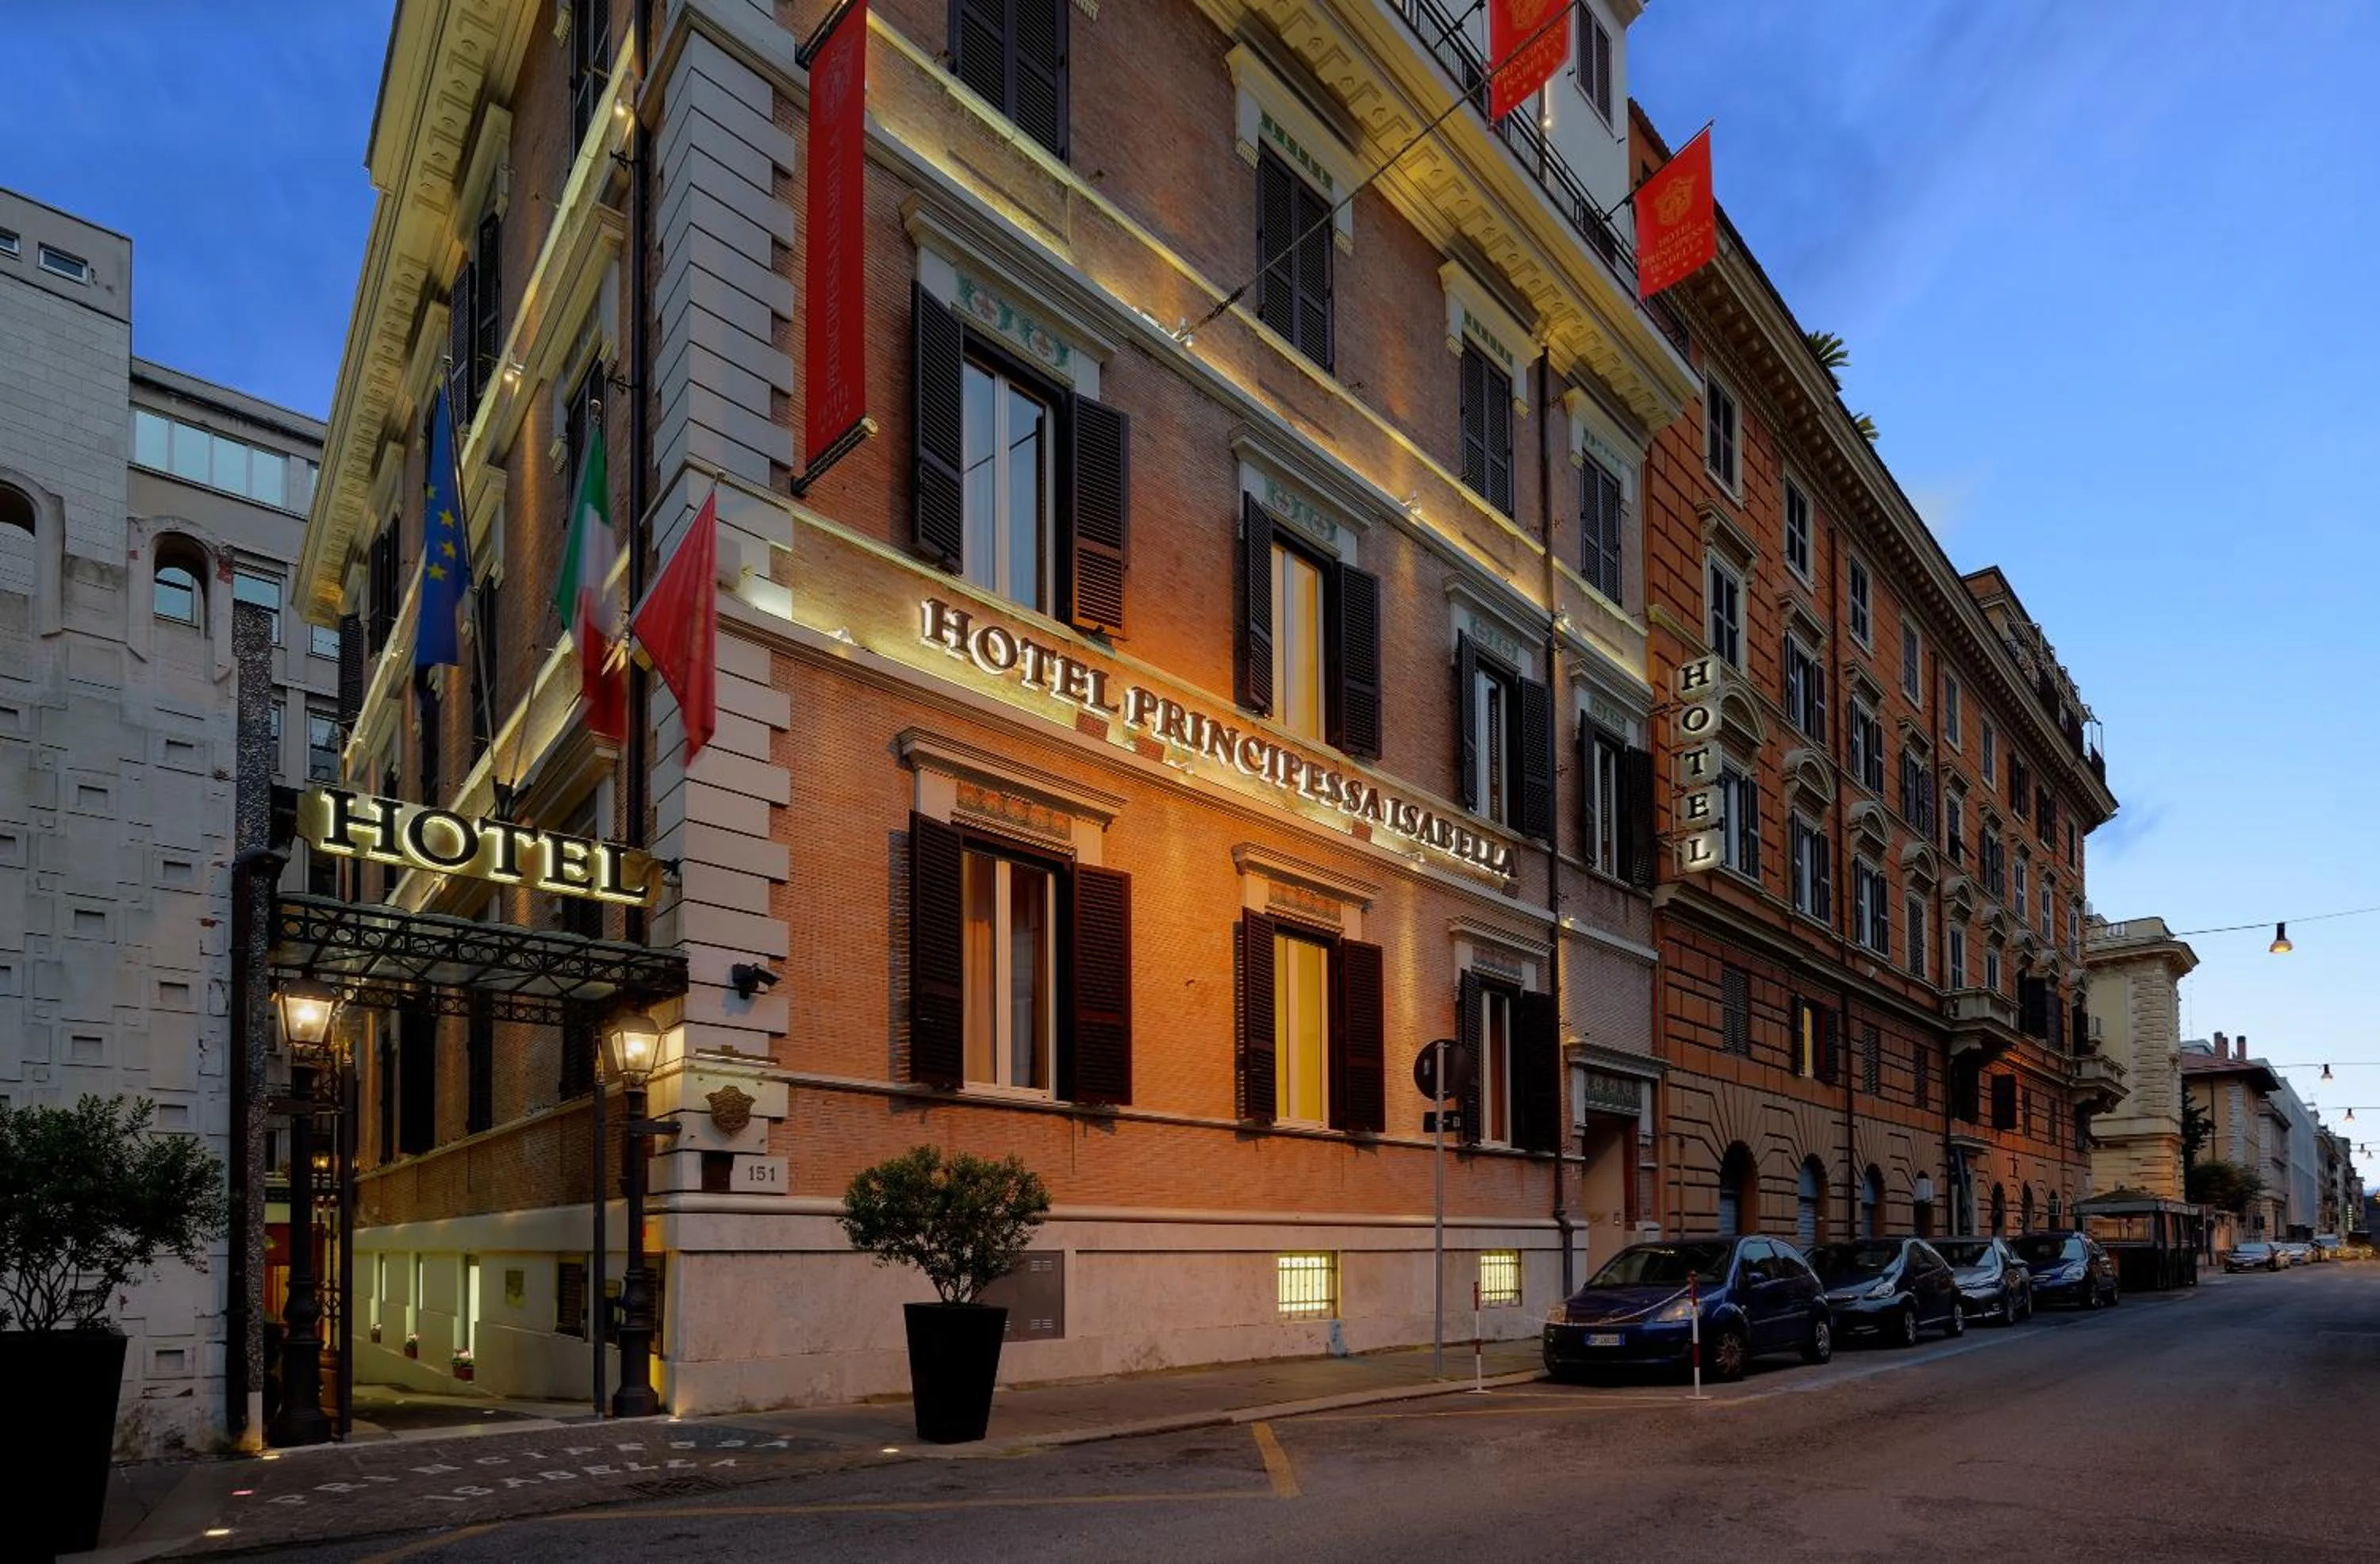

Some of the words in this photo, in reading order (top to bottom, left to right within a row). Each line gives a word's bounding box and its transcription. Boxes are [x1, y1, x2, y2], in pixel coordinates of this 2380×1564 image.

[922, 598, 1119, 715] HOTEL
[1125, 685, 1382, 822] PRINCIPESSA
[1386, 797, 1518, 878] ISABELLA
[1681, 661, 1710, 863] HOTEL
[321, 790, 649, 901] HOTEL
[749, 1165, 775, 1182] 151
